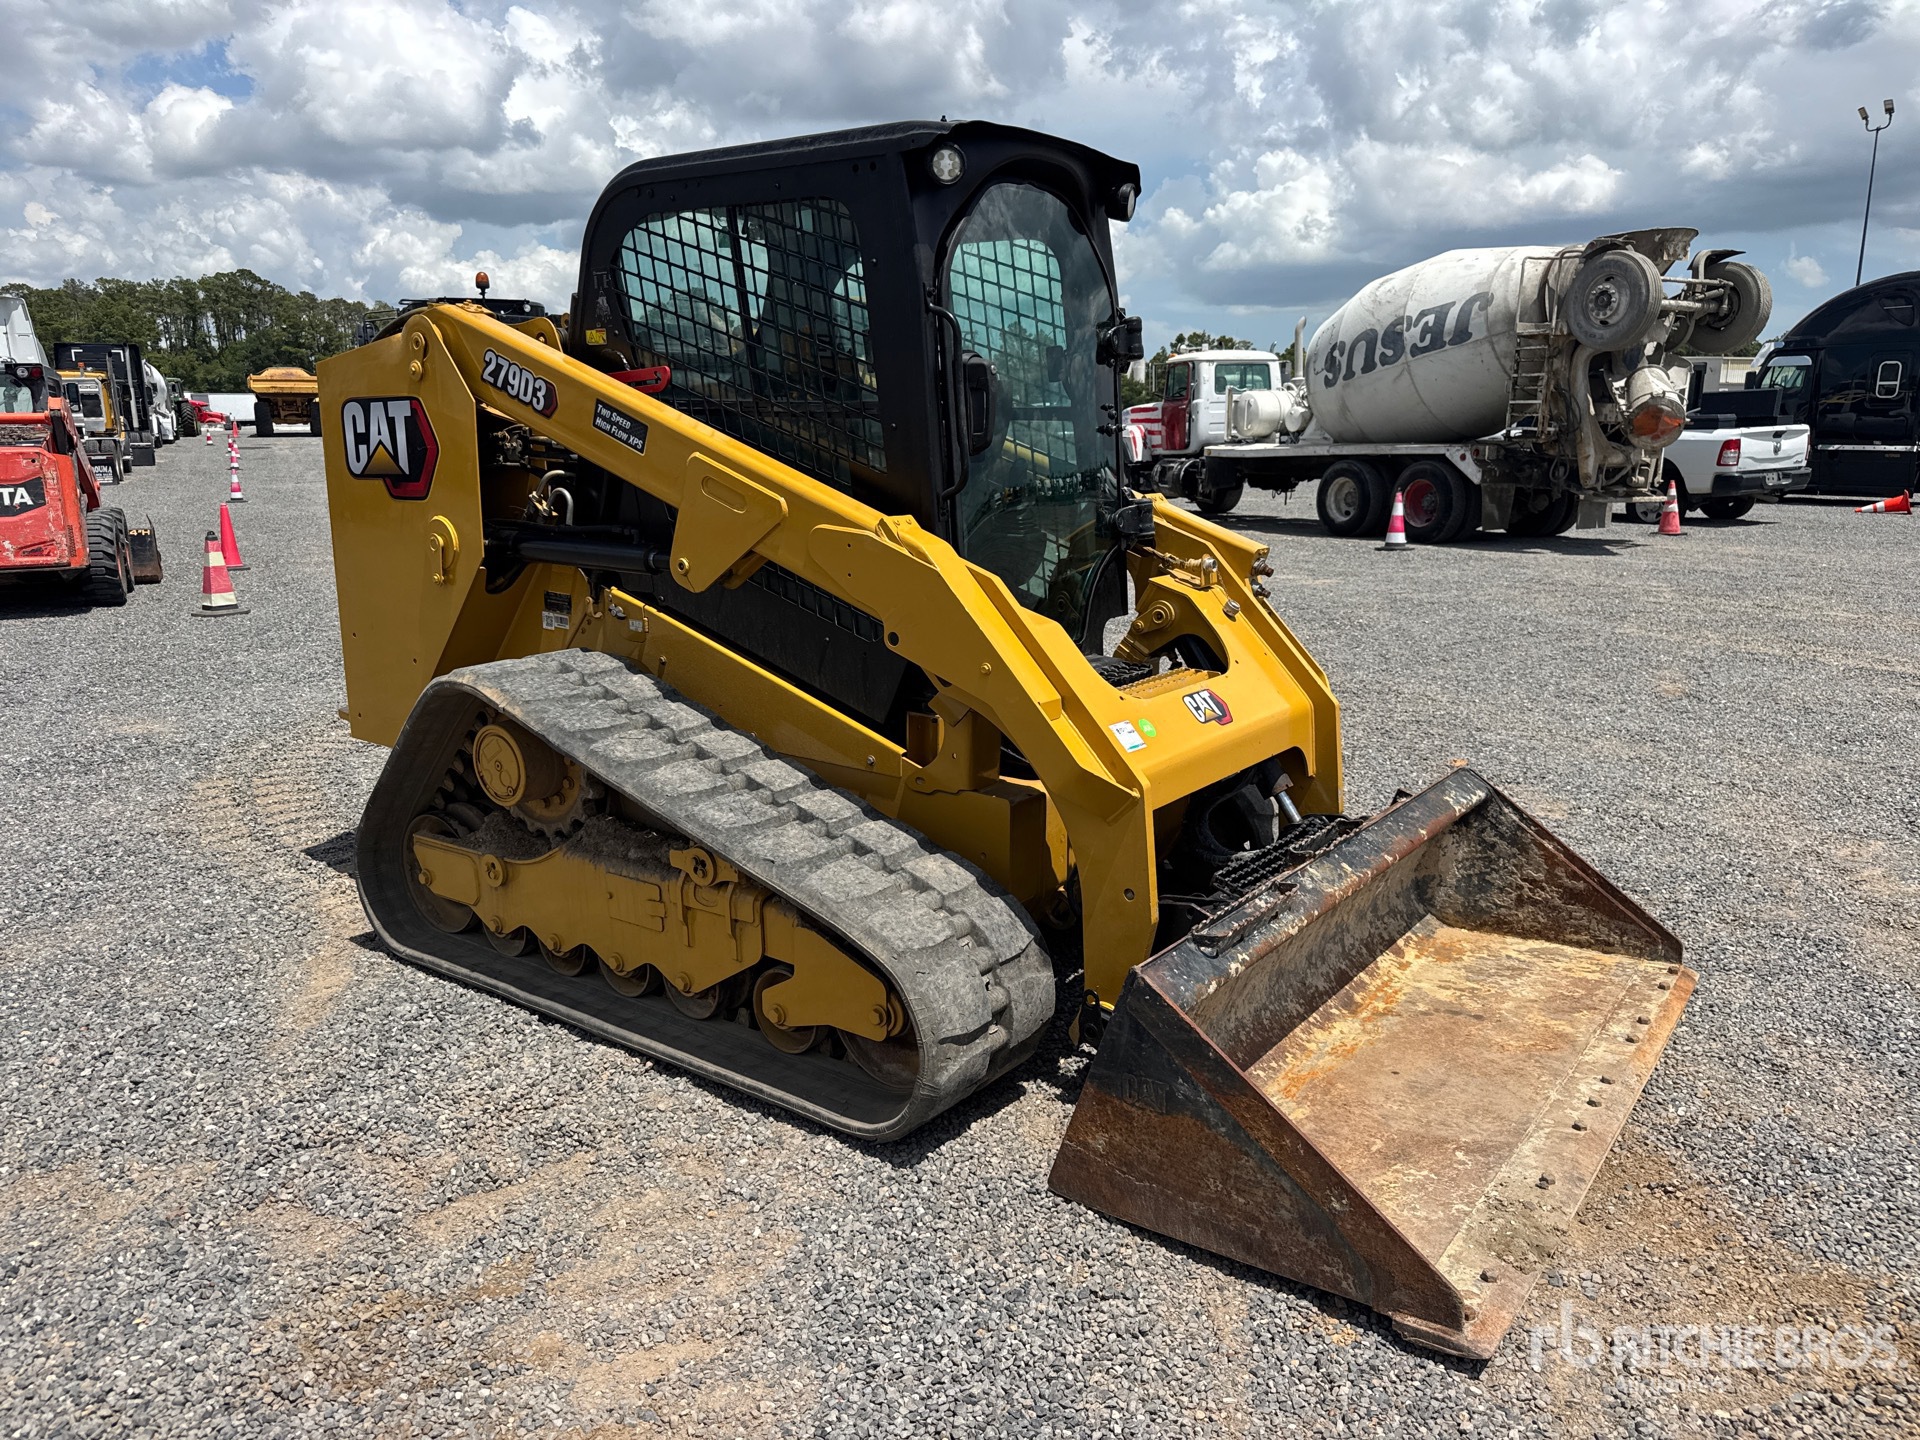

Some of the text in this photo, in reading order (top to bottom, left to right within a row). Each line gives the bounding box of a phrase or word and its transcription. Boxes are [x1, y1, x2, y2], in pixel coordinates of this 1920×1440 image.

[1323, 291, 1495, 389] JESUS
[482, 350, 547, 411] 279D3
[343, 400, 412, 475] CAT
[628, 435, 644, 450] XPS
[1183, 689, 1223, 723] CAT
